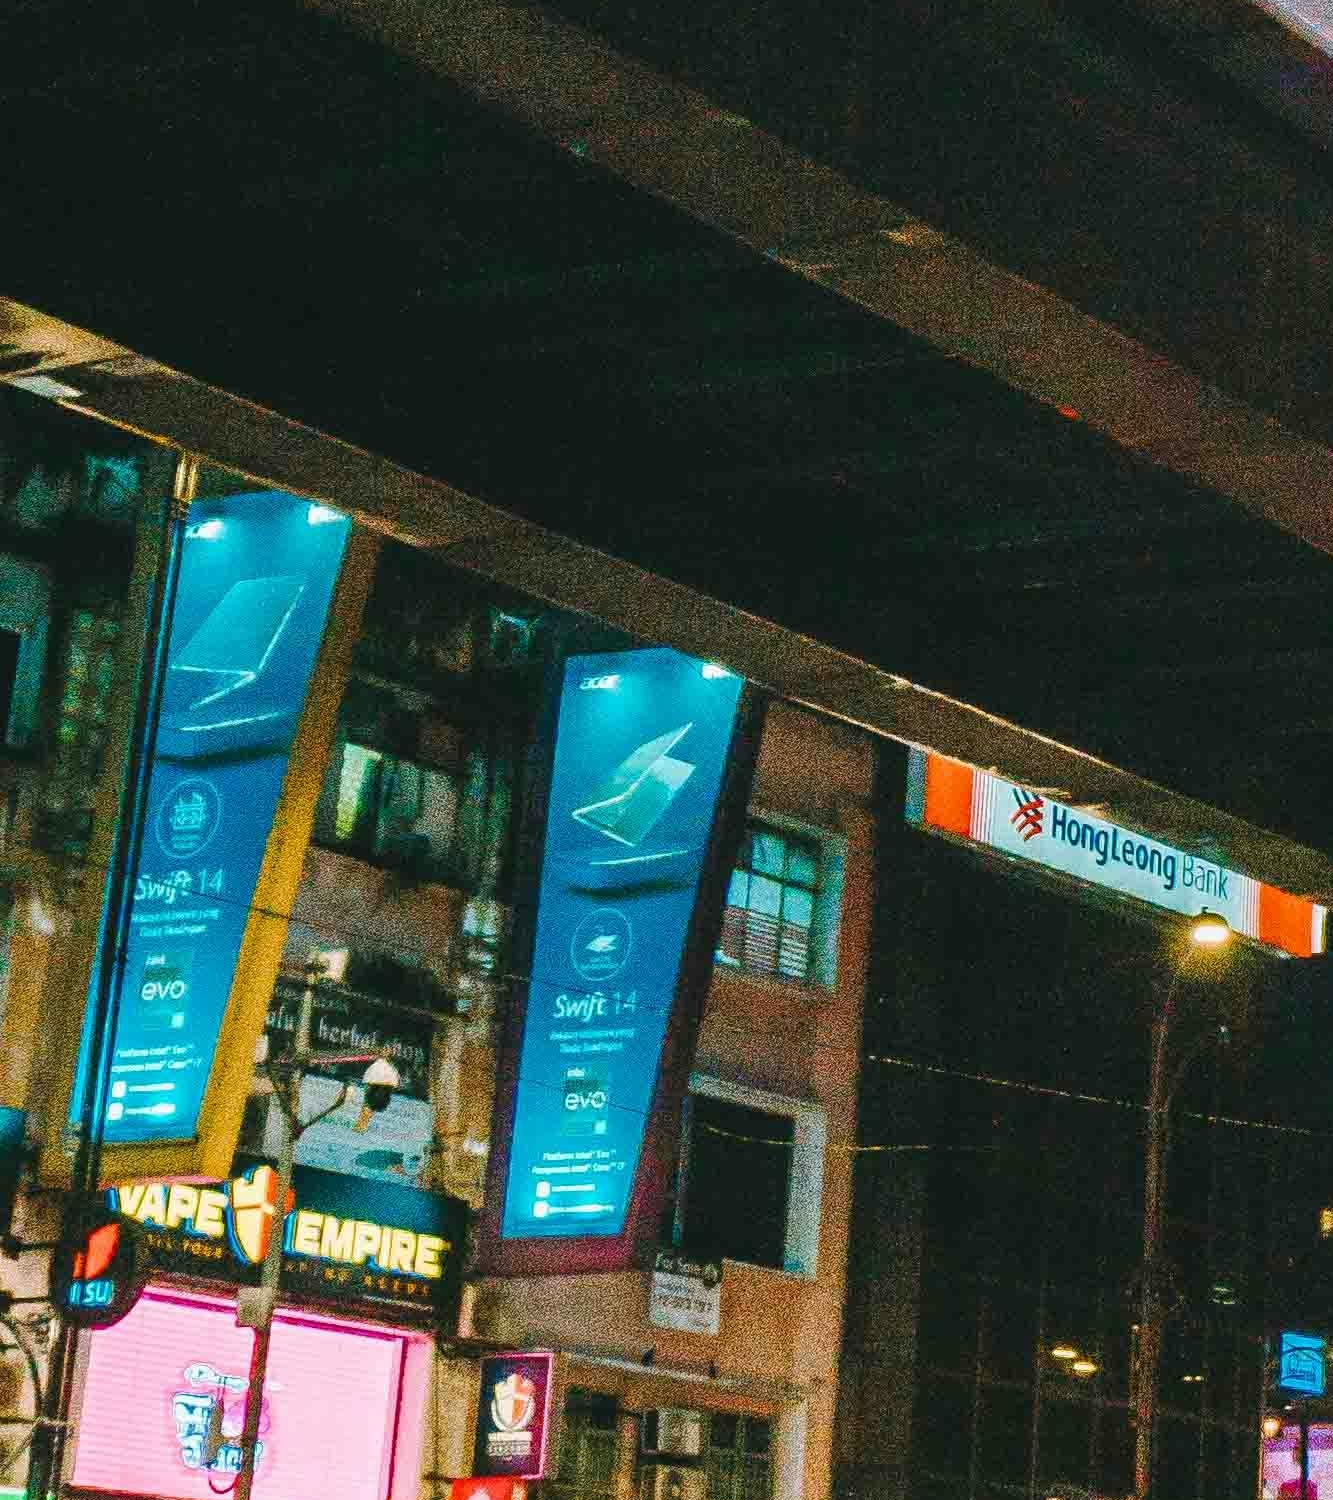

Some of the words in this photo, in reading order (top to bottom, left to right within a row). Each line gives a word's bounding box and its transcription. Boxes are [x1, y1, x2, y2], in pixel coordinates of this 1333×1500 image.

[199, 868, 224, 894] 14
[1183, 854, 1229, 901] Bank
[142, 980, 185, 1001] evo
[553, 993, 607, 1023] Swift
[612, 992, 638, 1016] 14
[564, 1090, 607, 1111] evo
[117, 1183, 228, 1239] VAPE
[292, 1208, 444, 1280] EMPIRE
